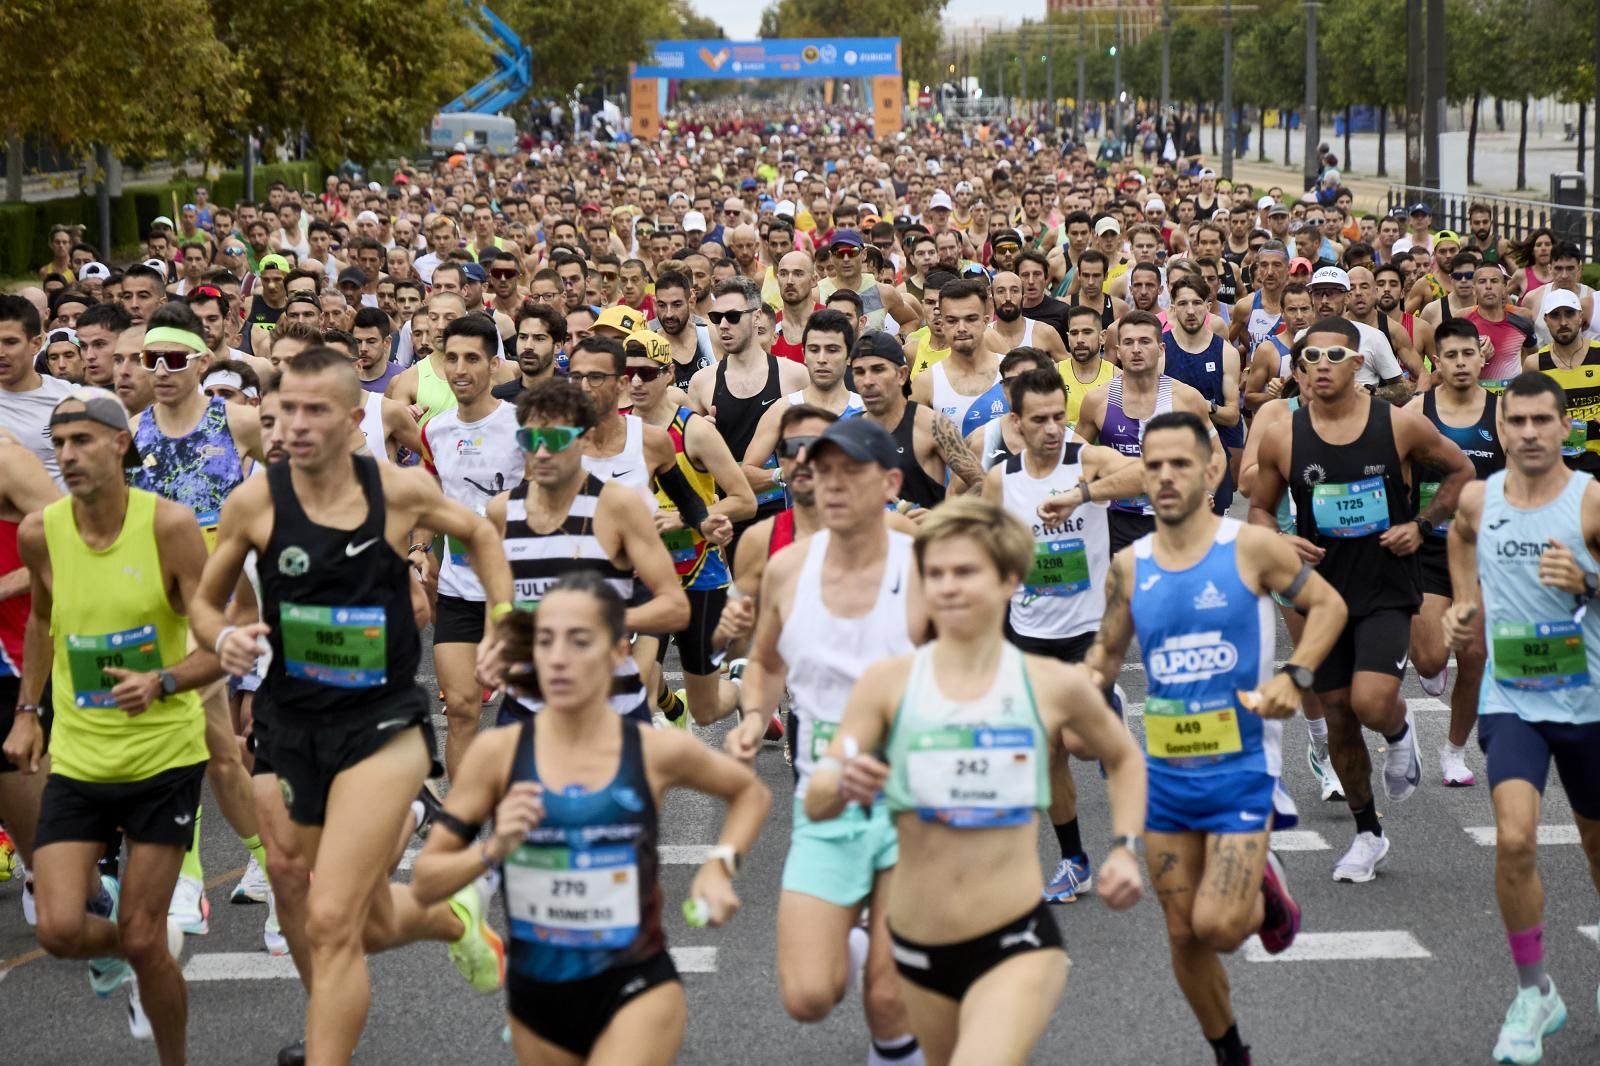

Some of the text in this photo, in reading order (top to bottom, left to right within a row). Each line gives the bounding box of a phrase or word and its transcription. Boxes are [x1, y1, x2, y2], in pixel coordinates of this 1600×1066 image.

[1336, 498, 1364, 511] 1725
[1340, 515, 1365, 526] Dylan
[1037, 557, 1064, 569] 1208
[316, 630, 345, 646] 985
[1523, 643, 1550, 657] 922
[1174, 721, 1202, 735] 449
[955, 758, 990, 777] 242
[552, 880, 587, 897] 270
